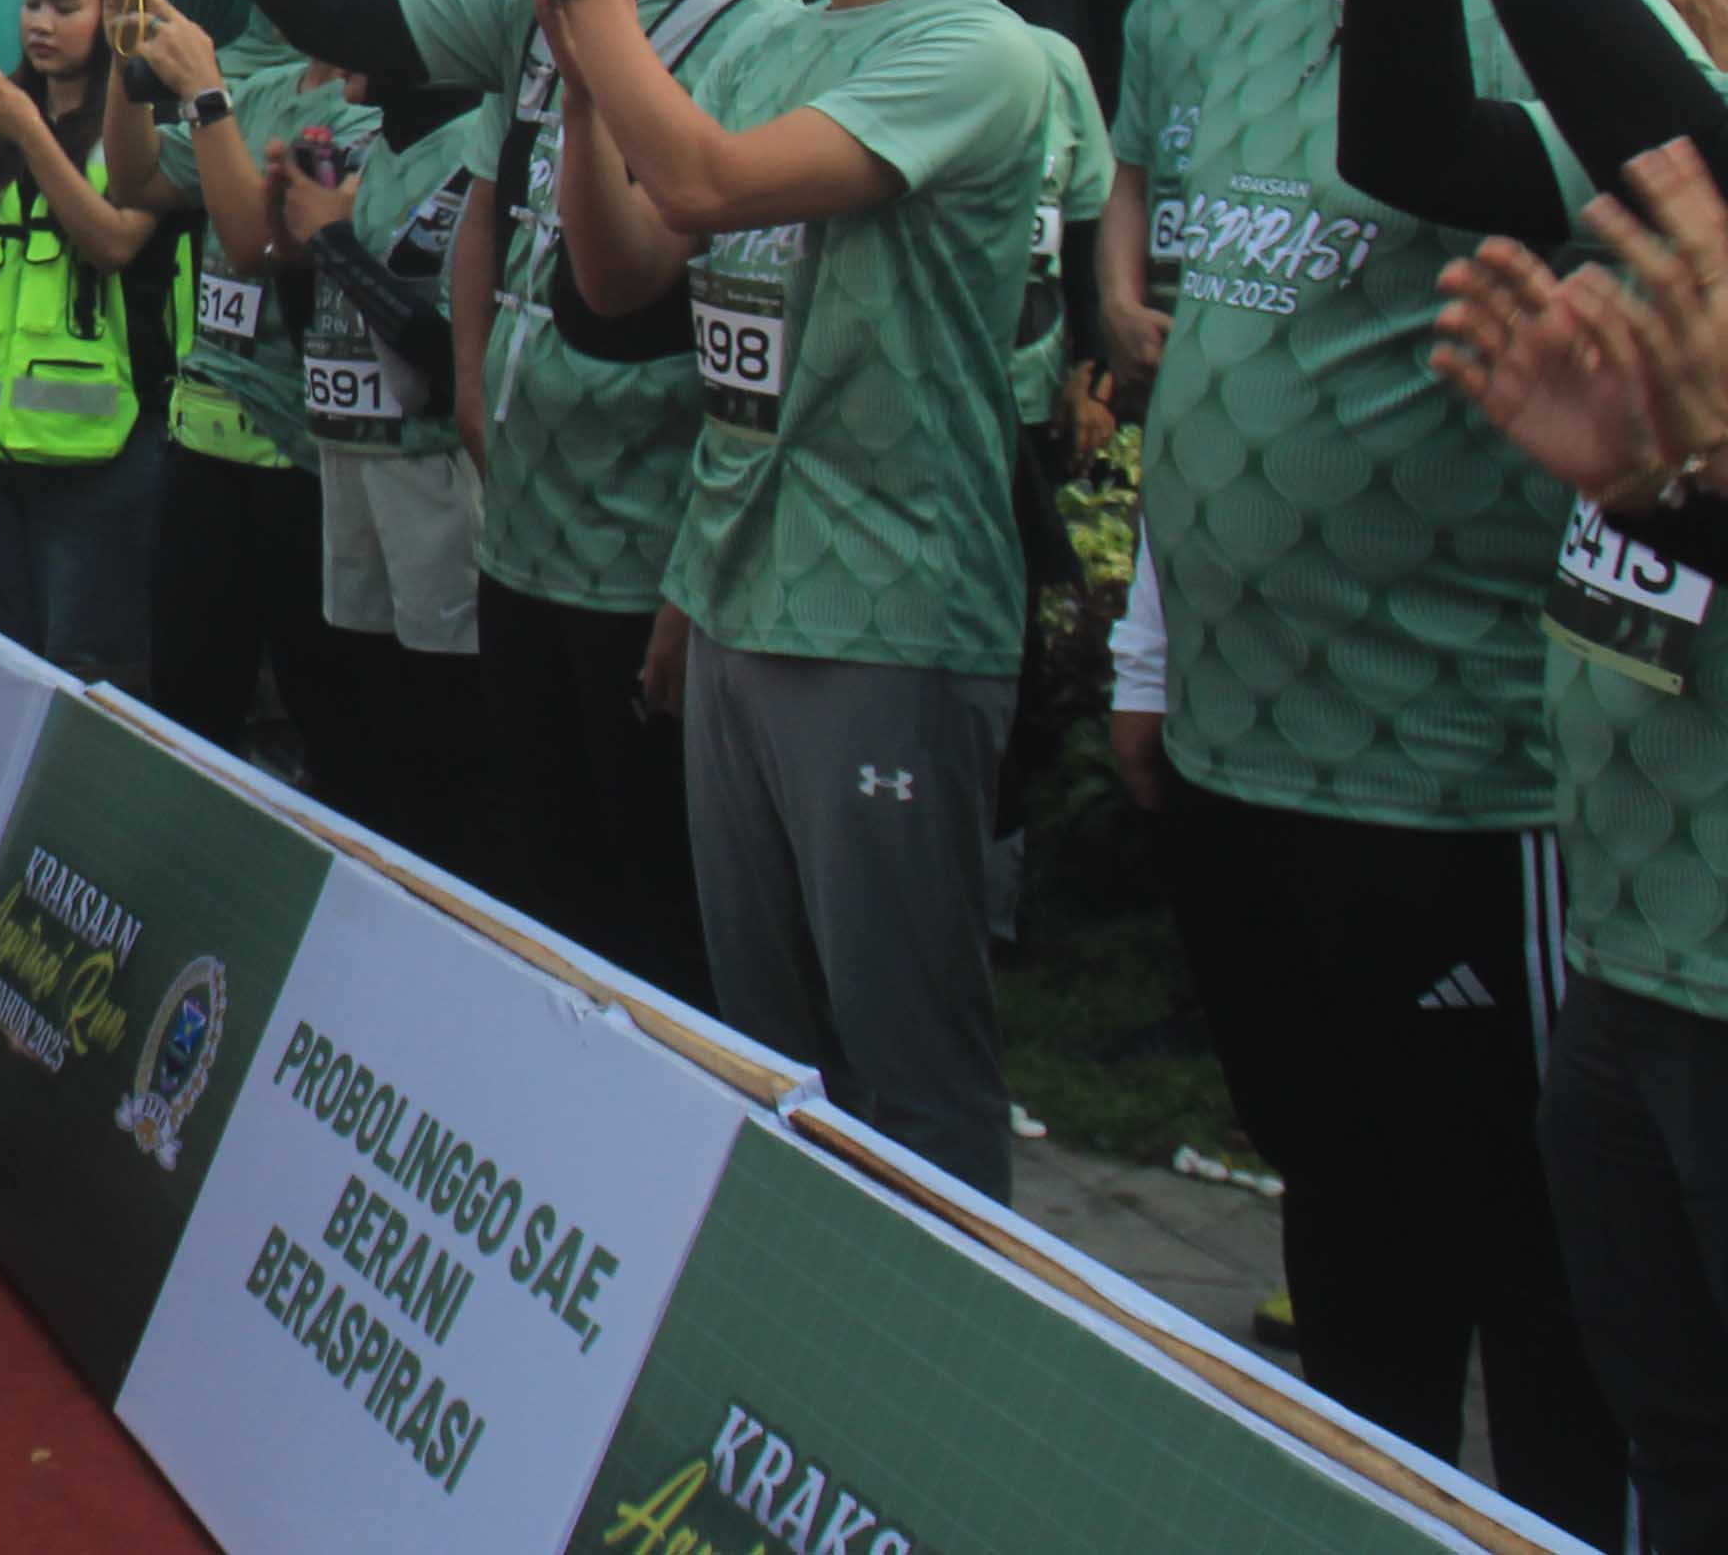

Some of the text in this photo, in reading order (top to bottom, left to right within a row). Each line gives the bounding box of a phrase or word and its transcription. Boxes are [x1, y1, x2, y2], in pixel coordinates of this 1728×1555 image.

[1183, 269, 1298, 314] RUN 2025
[306, 367, 382, 410] 691
[24, 845, 146, 971] KRAKSAAN
[28, 1018, 74, 1074] 2025
[272, 1019, 620, 1356] PROBOLINGGO SAE,
[322, 1174, 474, 1346] BERANI
[245, 1225, 487, 1496] BERASPIRASI
